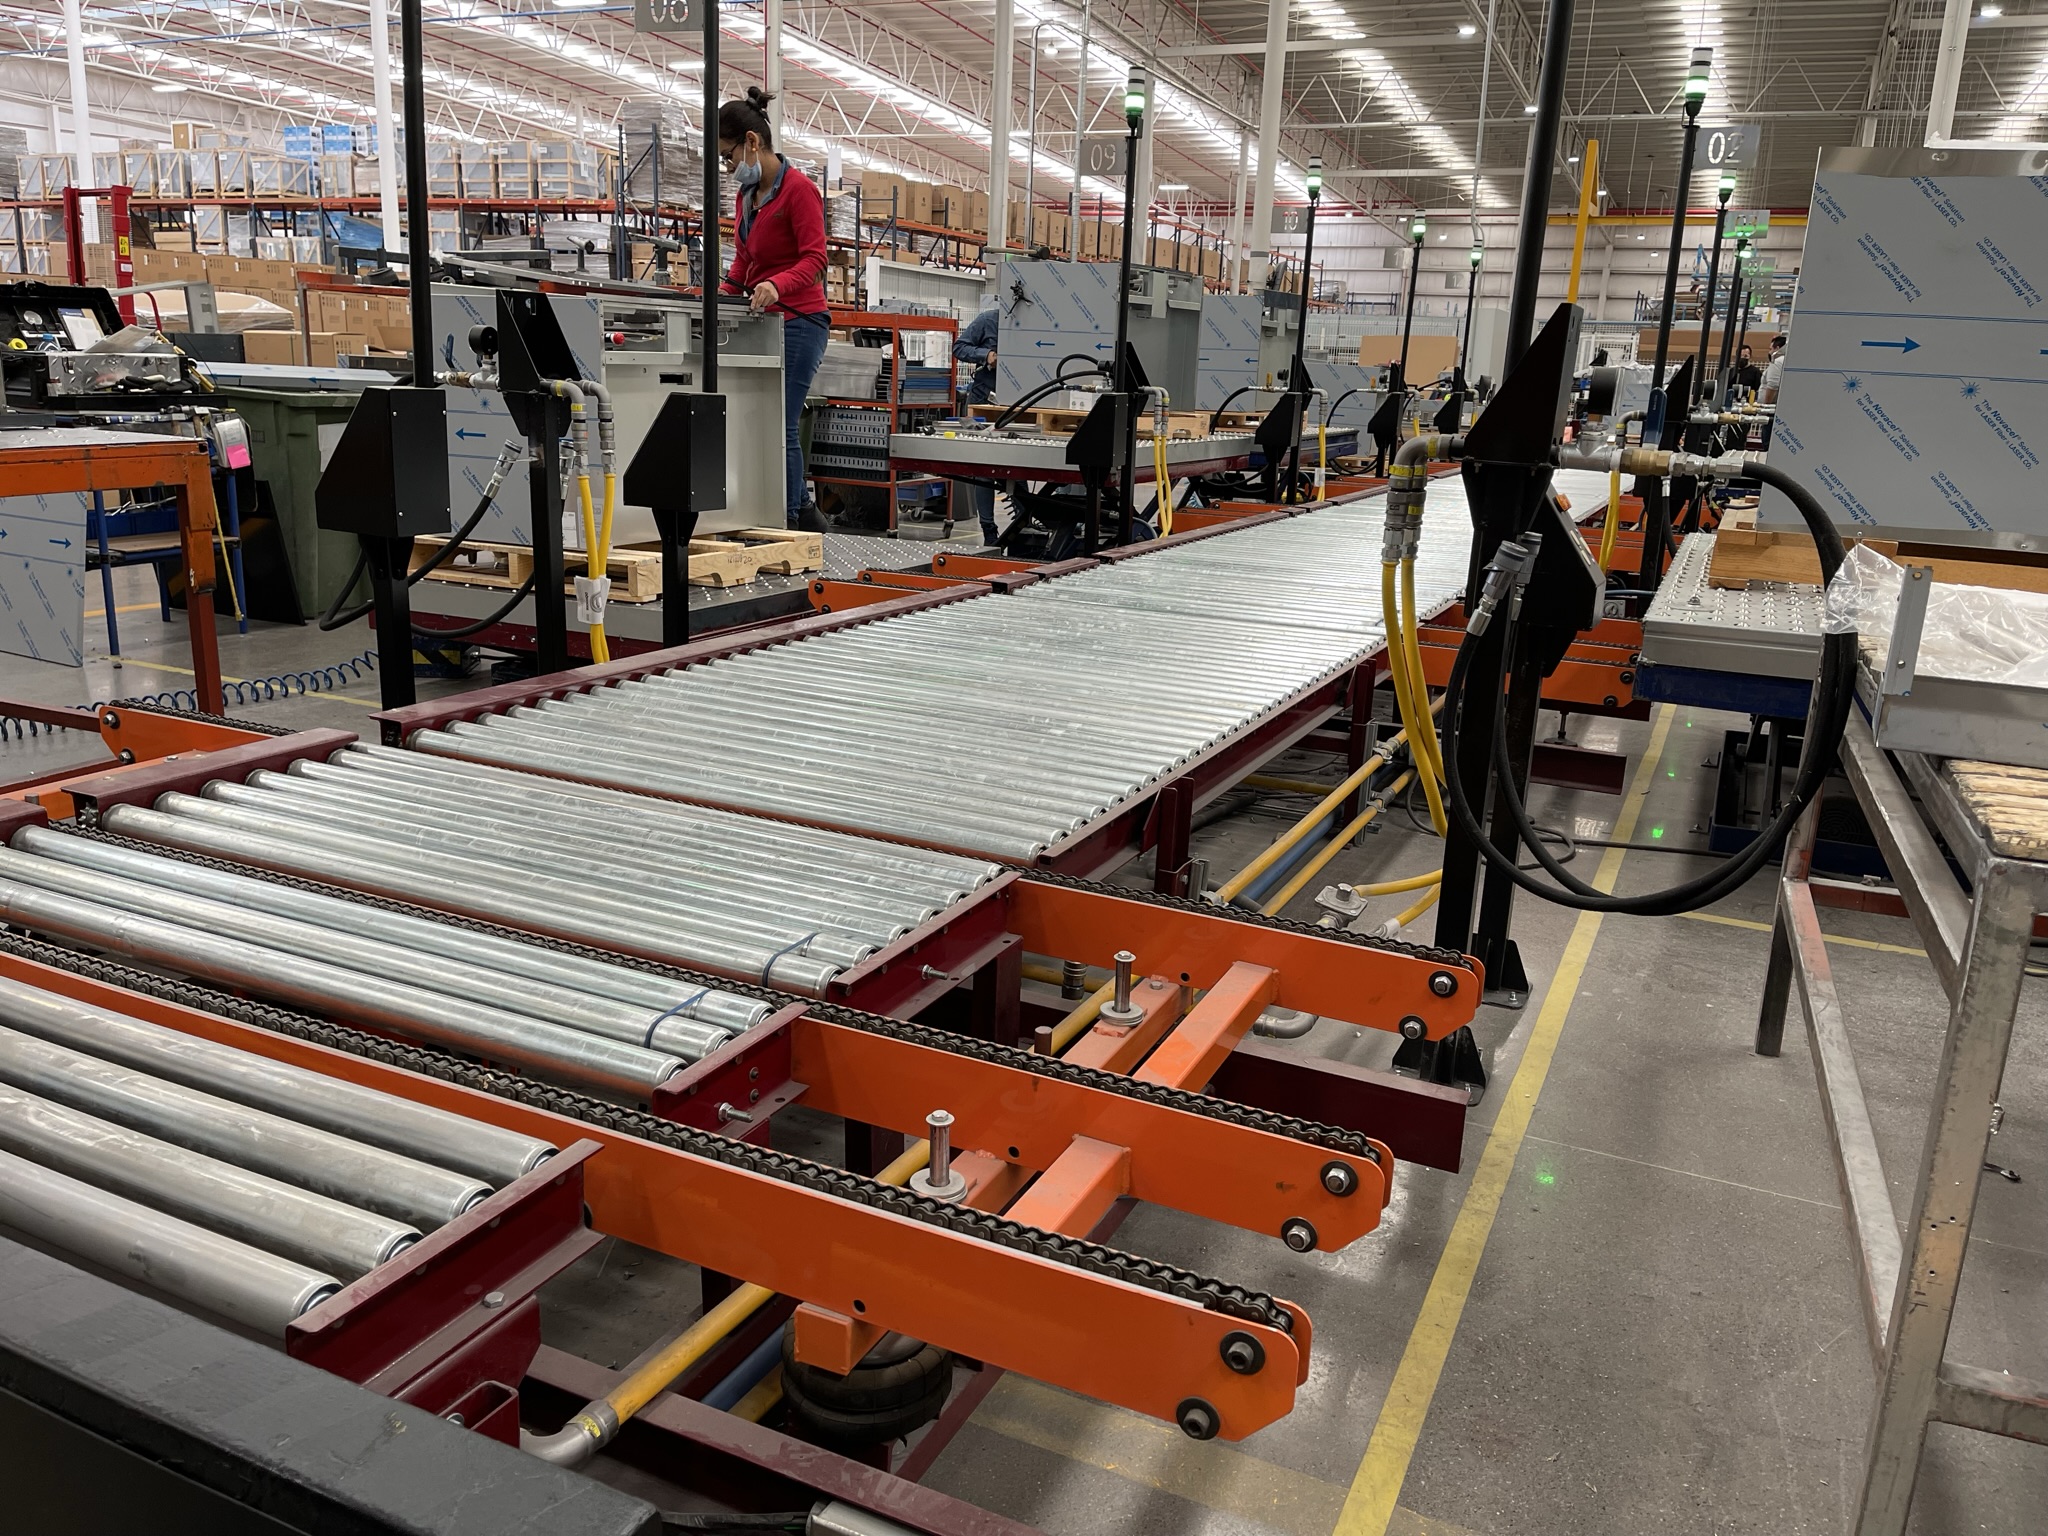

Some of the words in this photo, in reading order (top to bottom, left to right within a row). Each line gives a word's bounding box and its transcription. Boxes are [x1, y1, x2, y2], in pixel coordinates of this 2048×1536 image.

[1091, 144, 1116, 170] 09
[1708, 132, 1744, 164] 02
[1816, 198, 1831, 216] LASER
[1826, 196, 1847, 220] Solution
[1920, 185, 1932, 199] Fiber
[1934, 201, 1950, 218] LASER
[1944, 199, 1965, 222] Solution
[1284, 211, 1298, 230] 10
[1858, 238, 1878, 262] Solution
[1872, 242, 1888, 259] LASER
[1976, 242, 1997, 265] Solution
[1991, 246, 2007, 263] LASER
[1889, 261, 1901, 275] Fiber
[2008, 266, 2021, 279] Fiber
[1900, 273, 1916, 290] LASER
[2019, 278, 2036, 295] LASER
[1904, 291, 1915, 303] The
[1914, 289, 1922, 297] for
[2024, 296, 2034, 308] The
[2034, 294, 2043, 303] for
[1856, 398, 1864, 407] for
[1862, 405, 1878, 422] LASER
[1876, 420, 1888, 434] Fiber
[1889, 436, 1906, 453] LASER
[1863, 392, 1874, 405] The
[1899, 433, 1920, 457] Solution
[1974, 404, 1982, 413] for
[1981, 412, 1996, 429] LASER
[1994, 427, 2007, 441] Fiber
[2008, 443, 2025, 460] LASER
[1981, 399, 1992, 411] The
[2018, 441, 2040, 465] Solution
[1775, 430, 1790, 447] LASER
[1784, 428, 1804, 450] Solution
[1814, 468, 1835, 491] Solution
[1828, 472, 1844, 489] LASER
[1931, 475, 1952, 499] Solution
[1946, 480, 1962, 497] LASER
[1845, 490, 1858, 505] Fiber
[1962, 499, 1976, 513] Fiber
[1856, 502, 1871, 520] LASER
[1973, 511, 1990, 529] LASER
[1869, 517, 1878, 526] for
